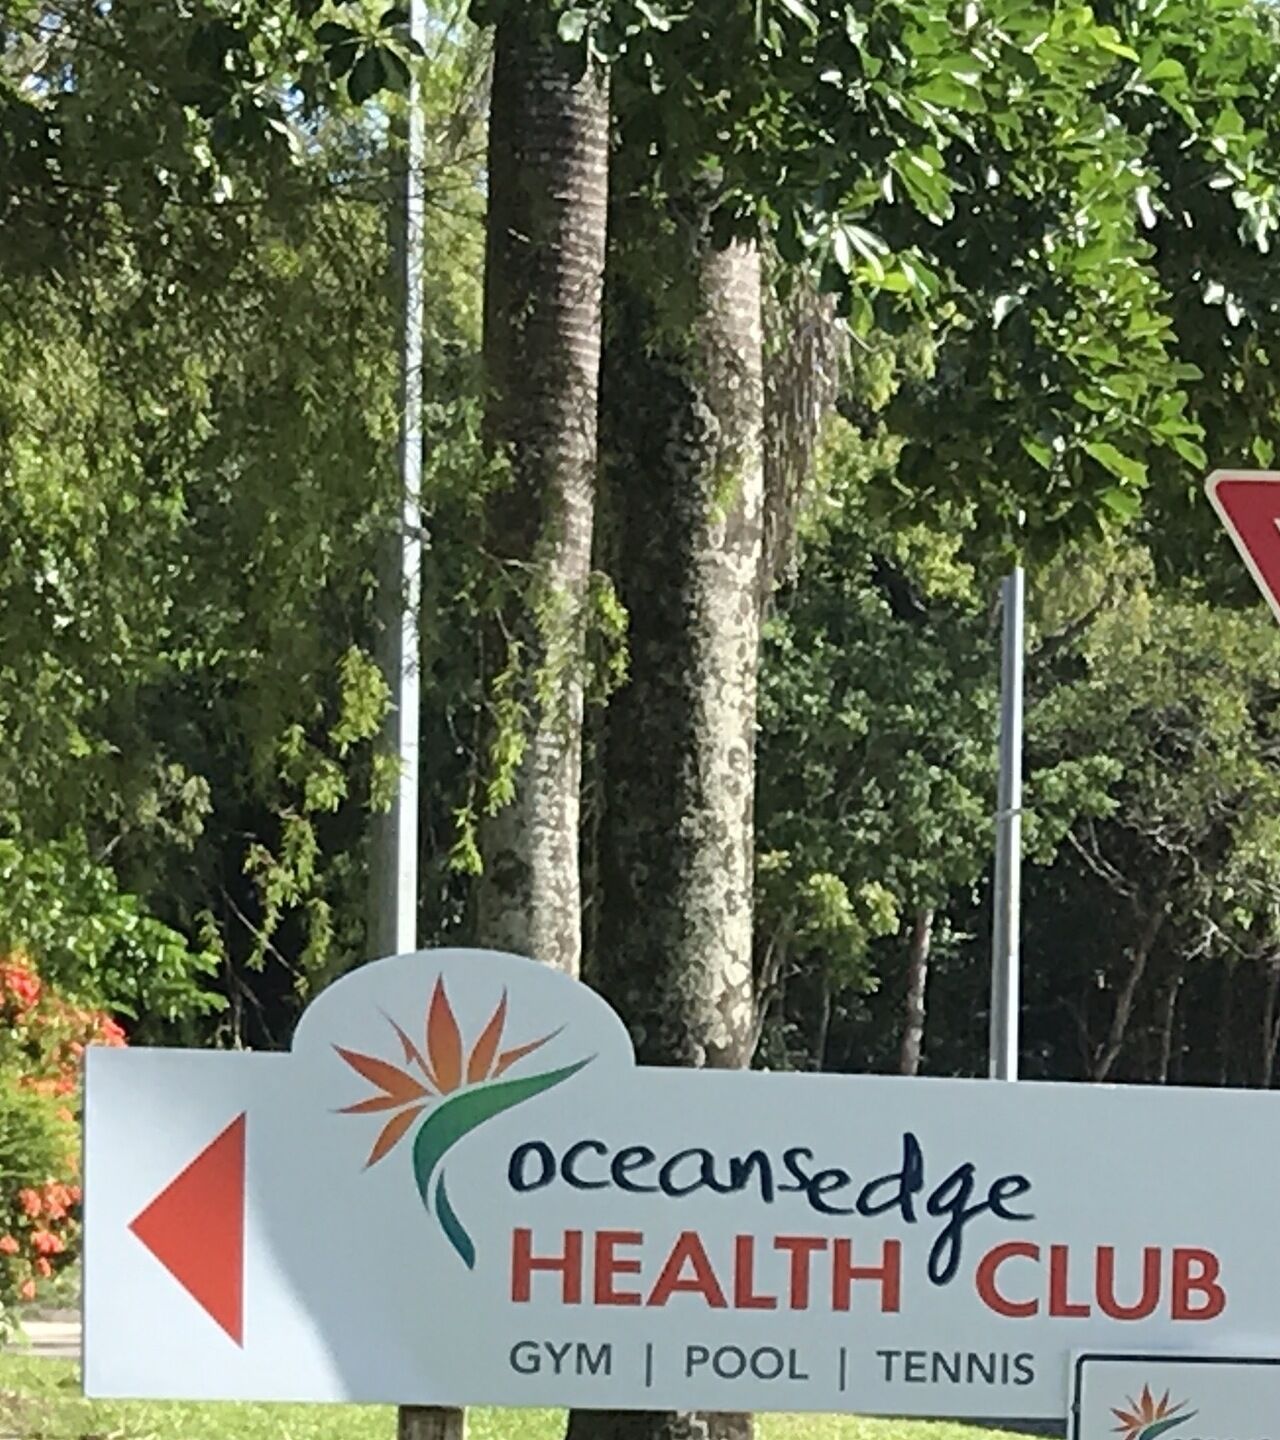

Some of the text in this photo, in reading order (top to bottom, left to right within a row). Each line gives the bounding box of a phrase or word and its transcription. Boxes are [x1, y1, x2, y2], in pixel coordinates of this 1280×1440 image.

[508, 1133, 1035, 1286] oceansedge
[511, 1228, 1227, 1321] HEALTH CLUB
[509, 1341, 613, 1377] GYM
[686, 1344, 810, 1382] POOL
[877, 1349, 1036, 1386] TENNIS
